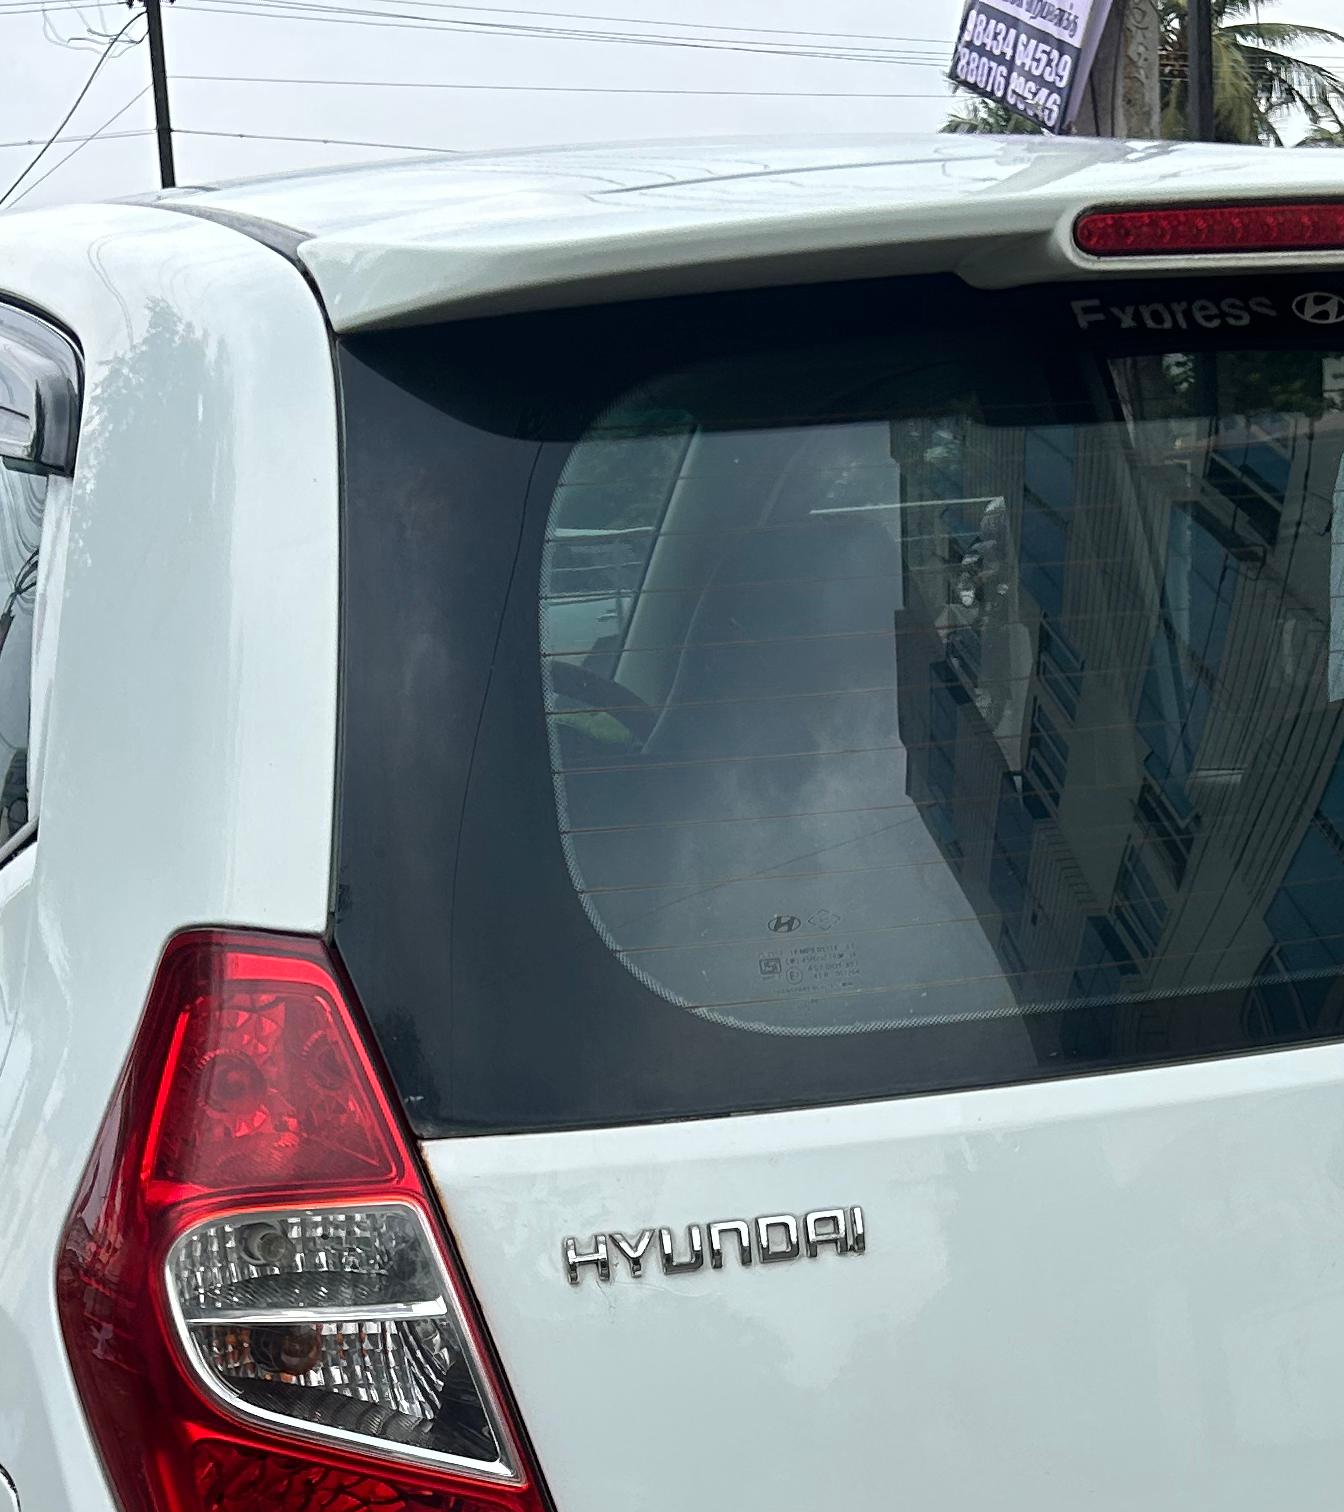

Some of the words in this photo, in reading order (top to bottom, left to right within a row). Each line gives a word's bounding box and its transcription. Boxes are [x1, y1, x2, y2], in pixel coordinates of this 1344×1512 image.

[962, 9, 1017, 61] 98434
[1015, 33, 1072, 88] 64539
[564, 1205, 866, 1285] HYUNDAI
